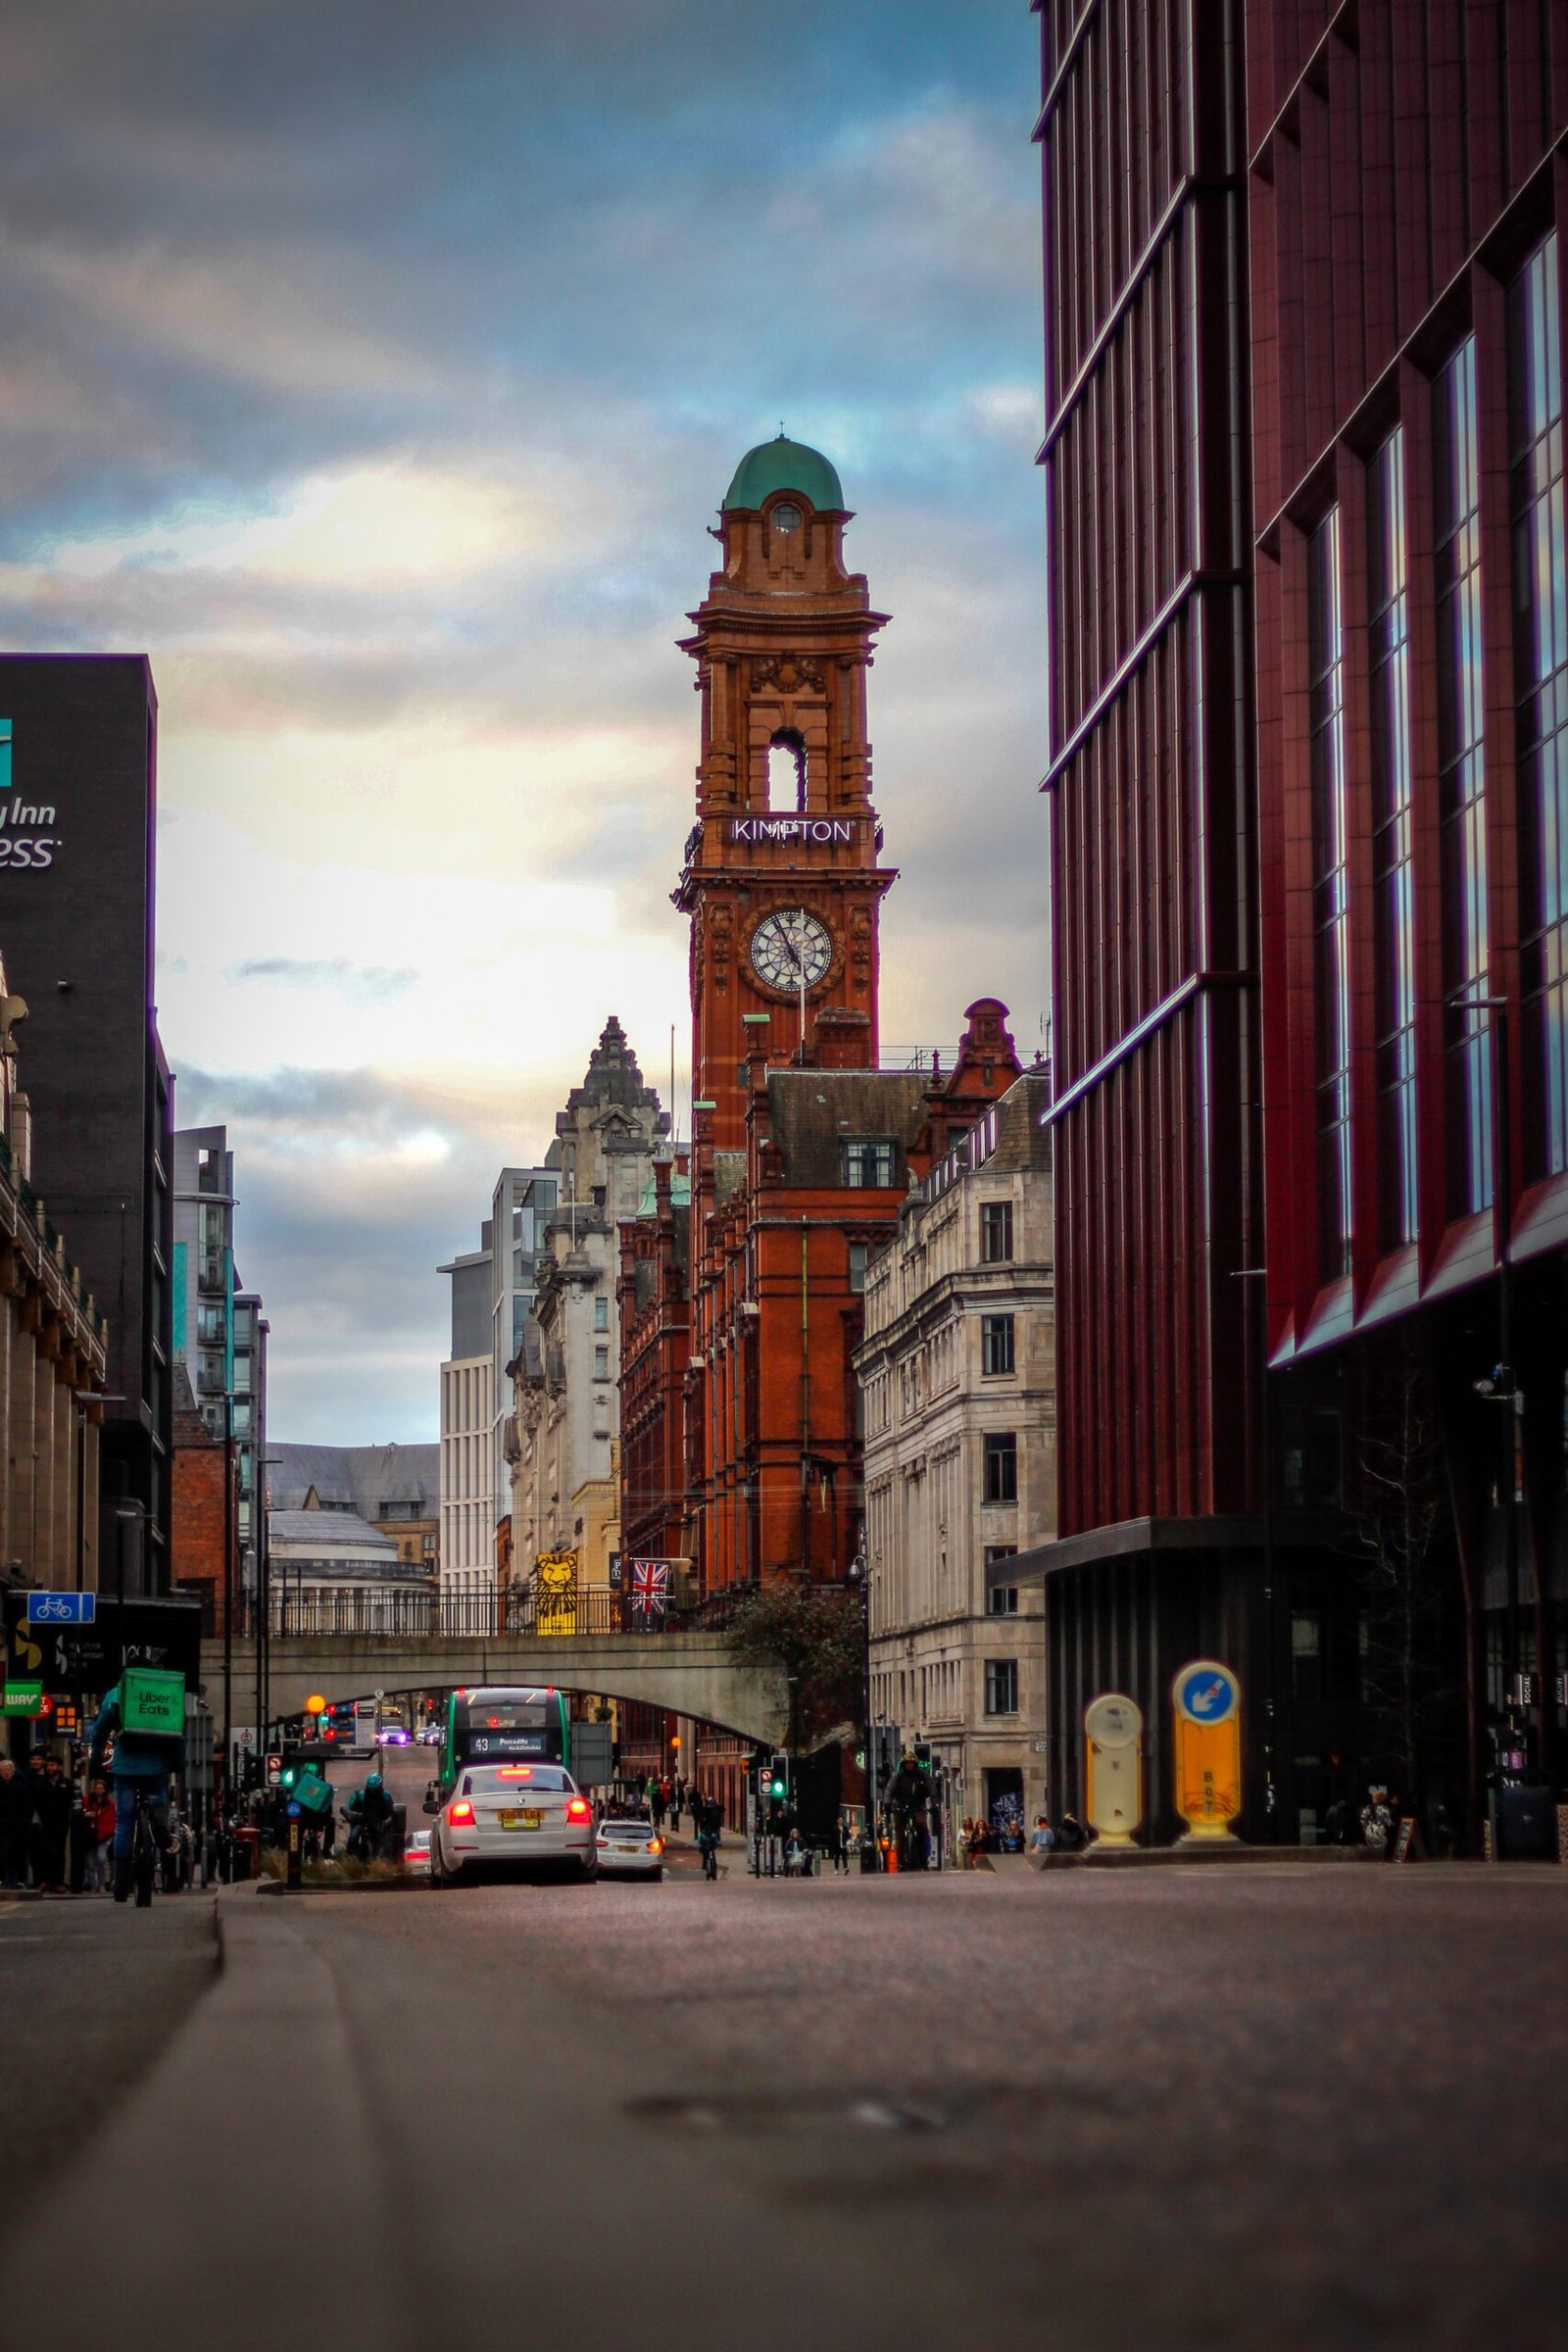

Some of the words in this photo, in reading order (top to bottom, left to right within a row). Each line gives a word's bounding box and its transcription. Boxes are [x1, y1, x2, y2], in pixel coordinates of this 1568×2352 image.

[11, 797, 56, 825] Inn
[735, 820, 851, 841] KIMPTON
[139, 1690, 171, 1703] Uber
[139, 1703, 170, 1716] Eats
[475, 1739, 489, 1751] 43
